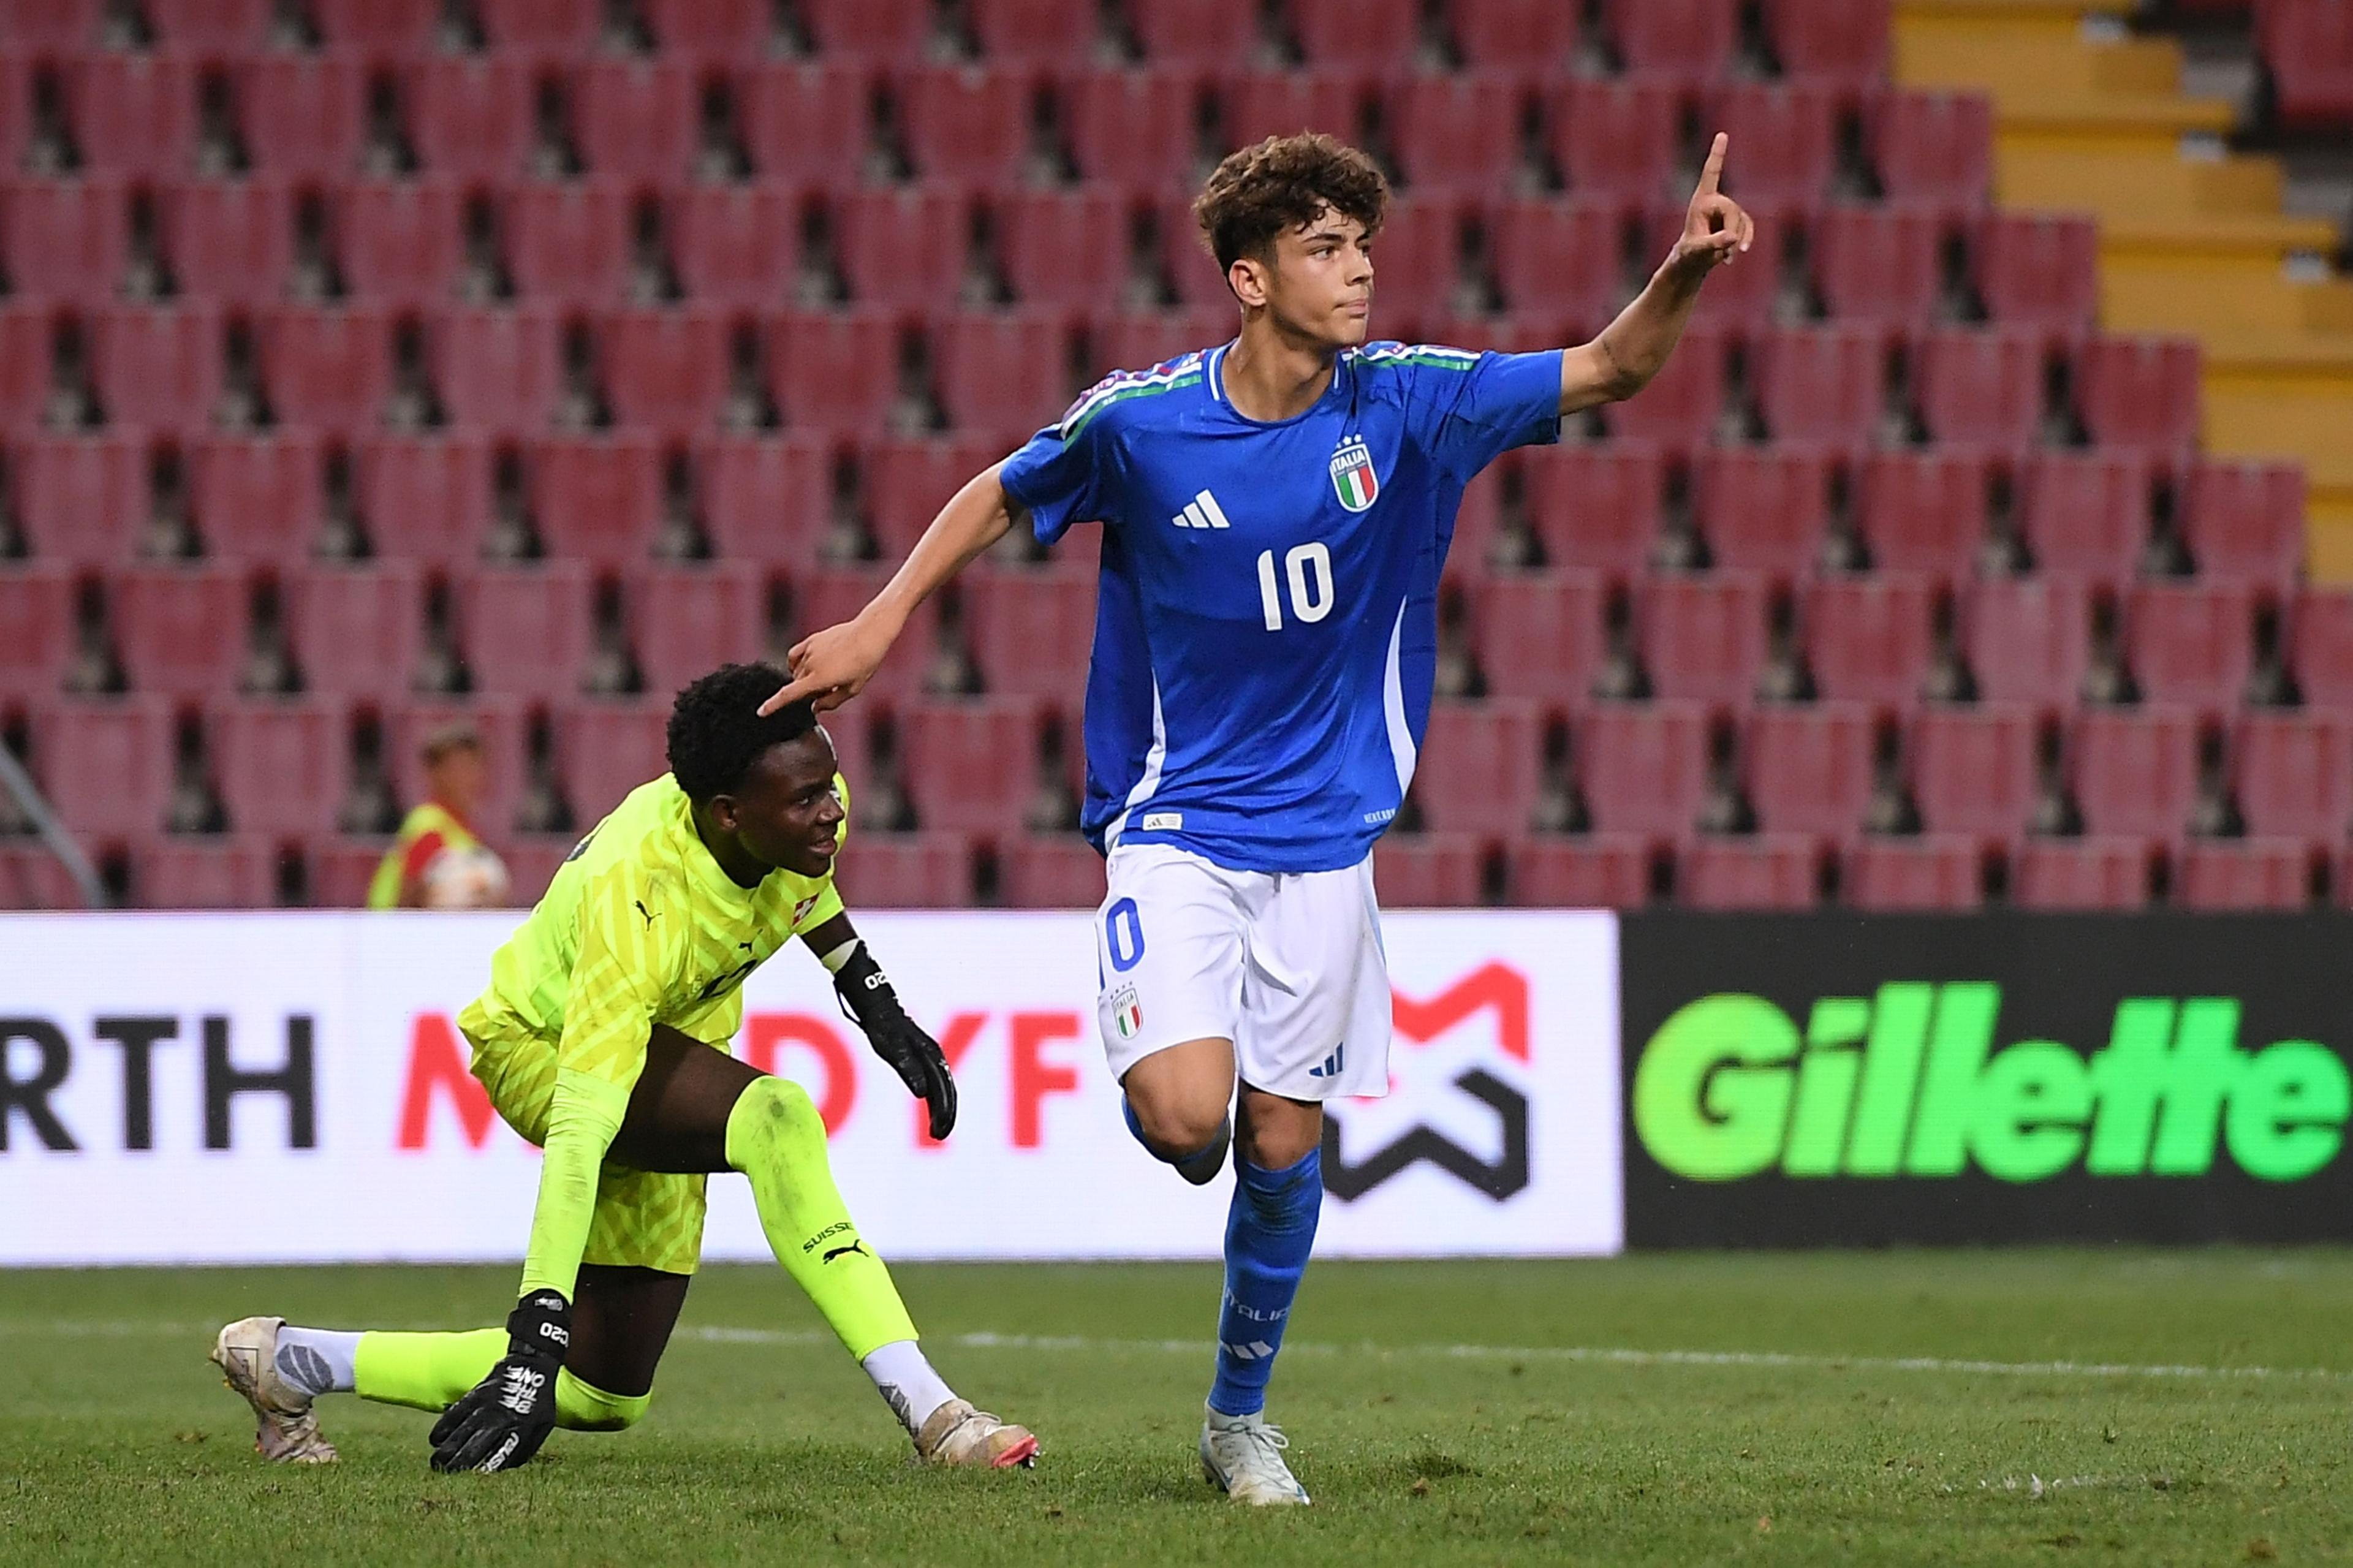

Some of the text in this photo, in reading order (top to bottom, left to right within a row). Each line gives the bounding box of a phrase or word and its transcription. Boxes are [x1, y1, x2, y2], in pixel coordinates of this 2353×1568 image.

[1330, 449, 1366, 473] ITALIA
[1257, 542, 1335, 632] 10
[396, 1014, 1079, 1149] MDYF
[1632, 980, 2351, 1181] Gillette
[803, 1222, 854, 1254] SUISSE
